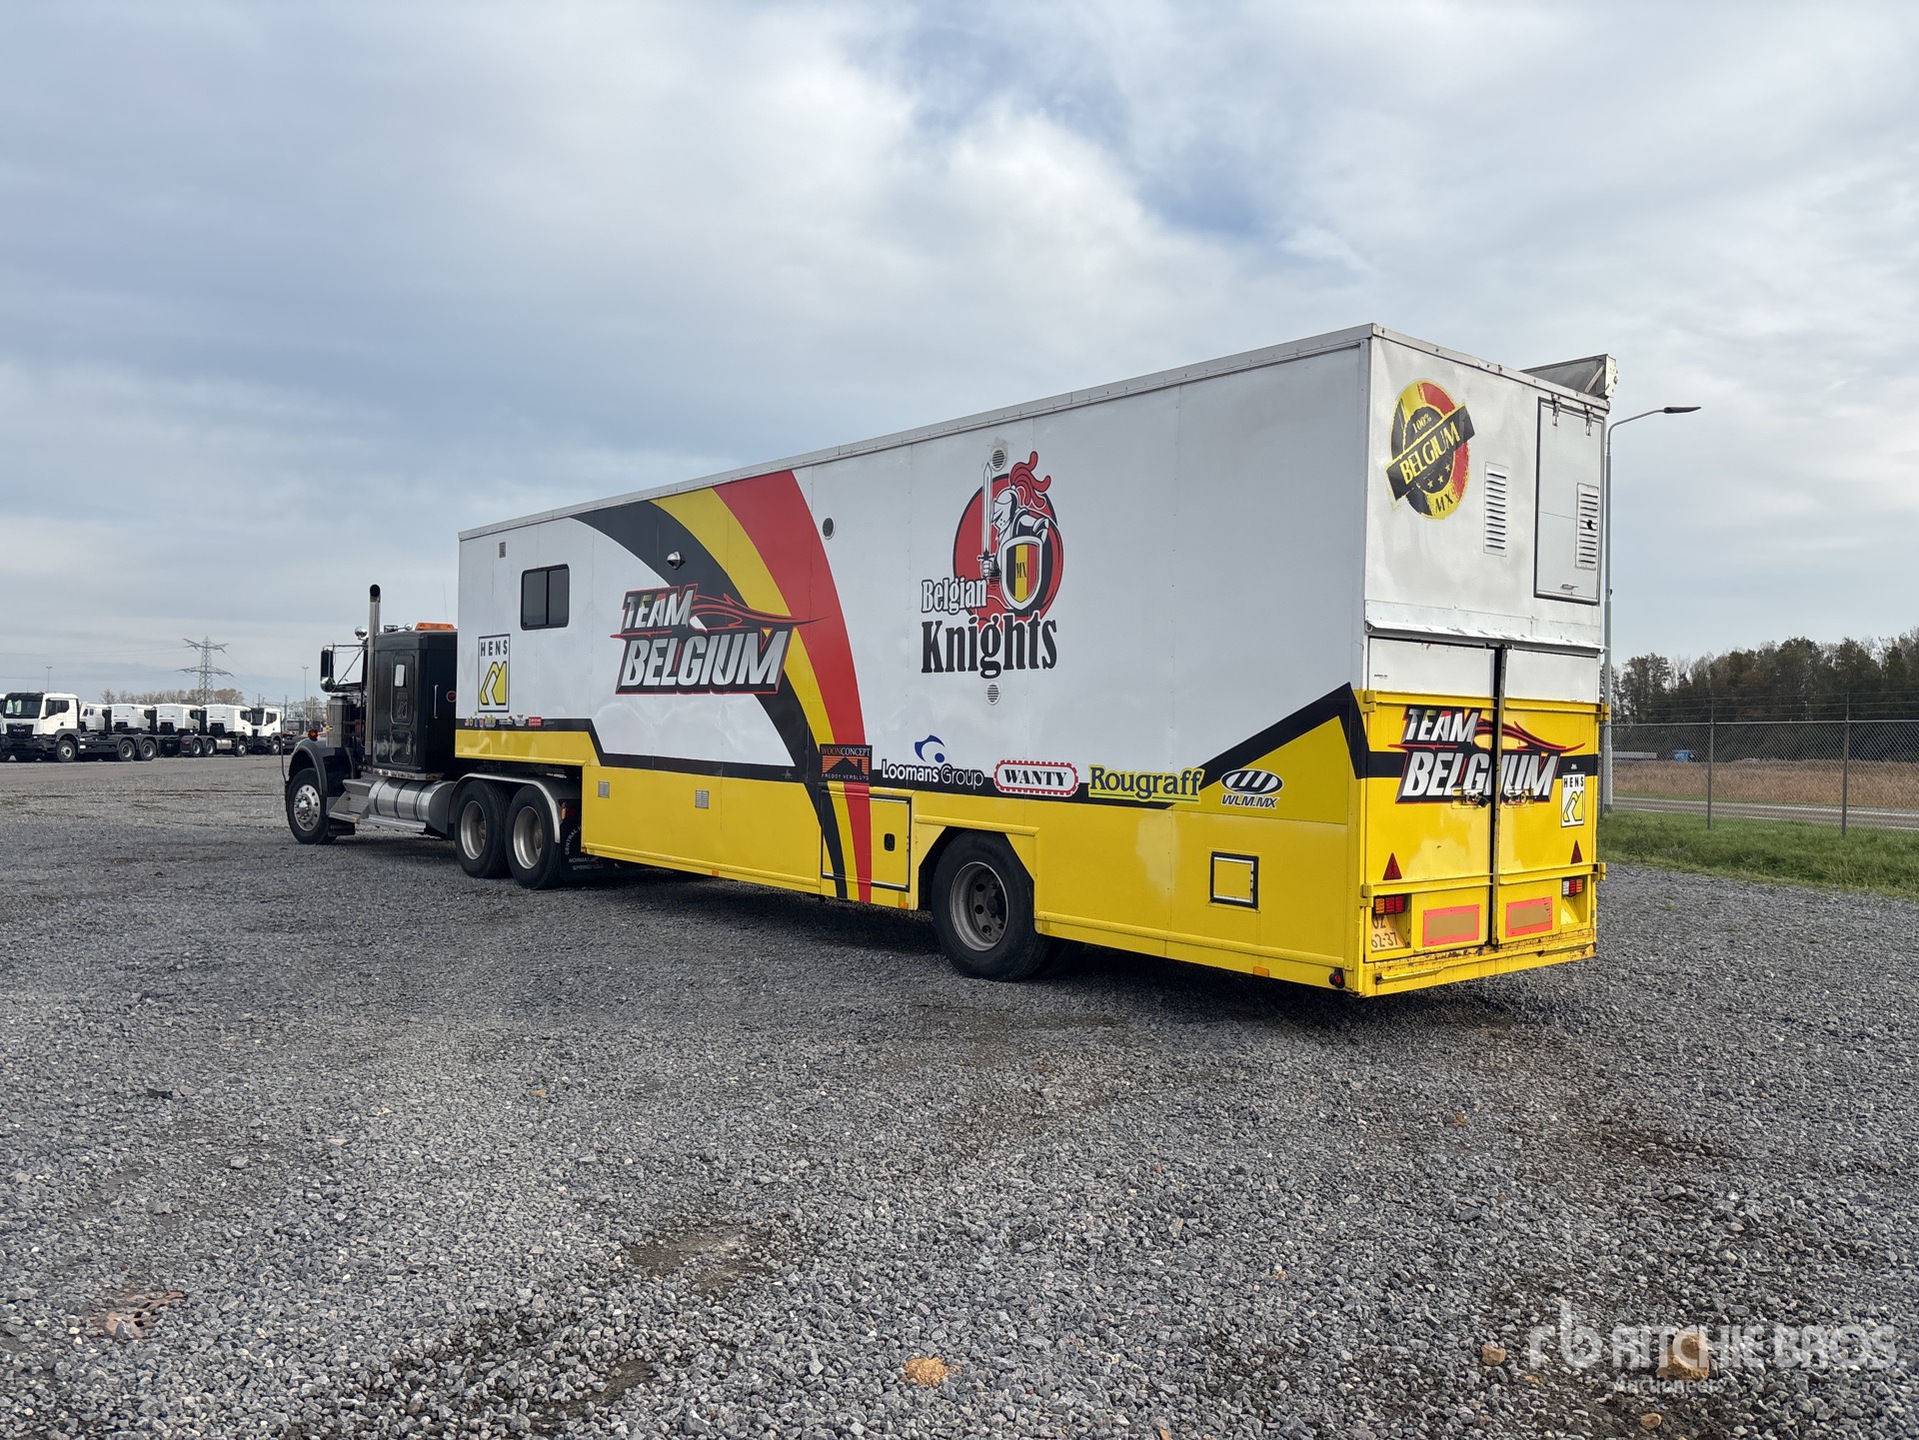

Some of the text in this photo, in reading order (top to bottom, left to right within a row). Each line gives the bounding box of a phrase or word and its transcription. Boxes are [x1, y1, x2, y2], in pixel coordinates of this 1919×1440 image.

[1399, 421, 1460, 485] BELGIUM
[1435, 492, 1454, 513] MX
[1016, 562, 1027, 579] MX
[625, 589, 695, 630] TEAM
[921, 577, 988, 615] Belgian
[480, 639, 508, 657] HENS
[620, 630, 789, 687] BELGIUM
[921, 612, 1058, 680] Knights
[1406, 708, 1480, 746] TEAM
[1004, 769, 1068, 786] WANTY
[1089, 767, 1203, 799] Rougraff
[1563, 776, 1584, 788] HENS
